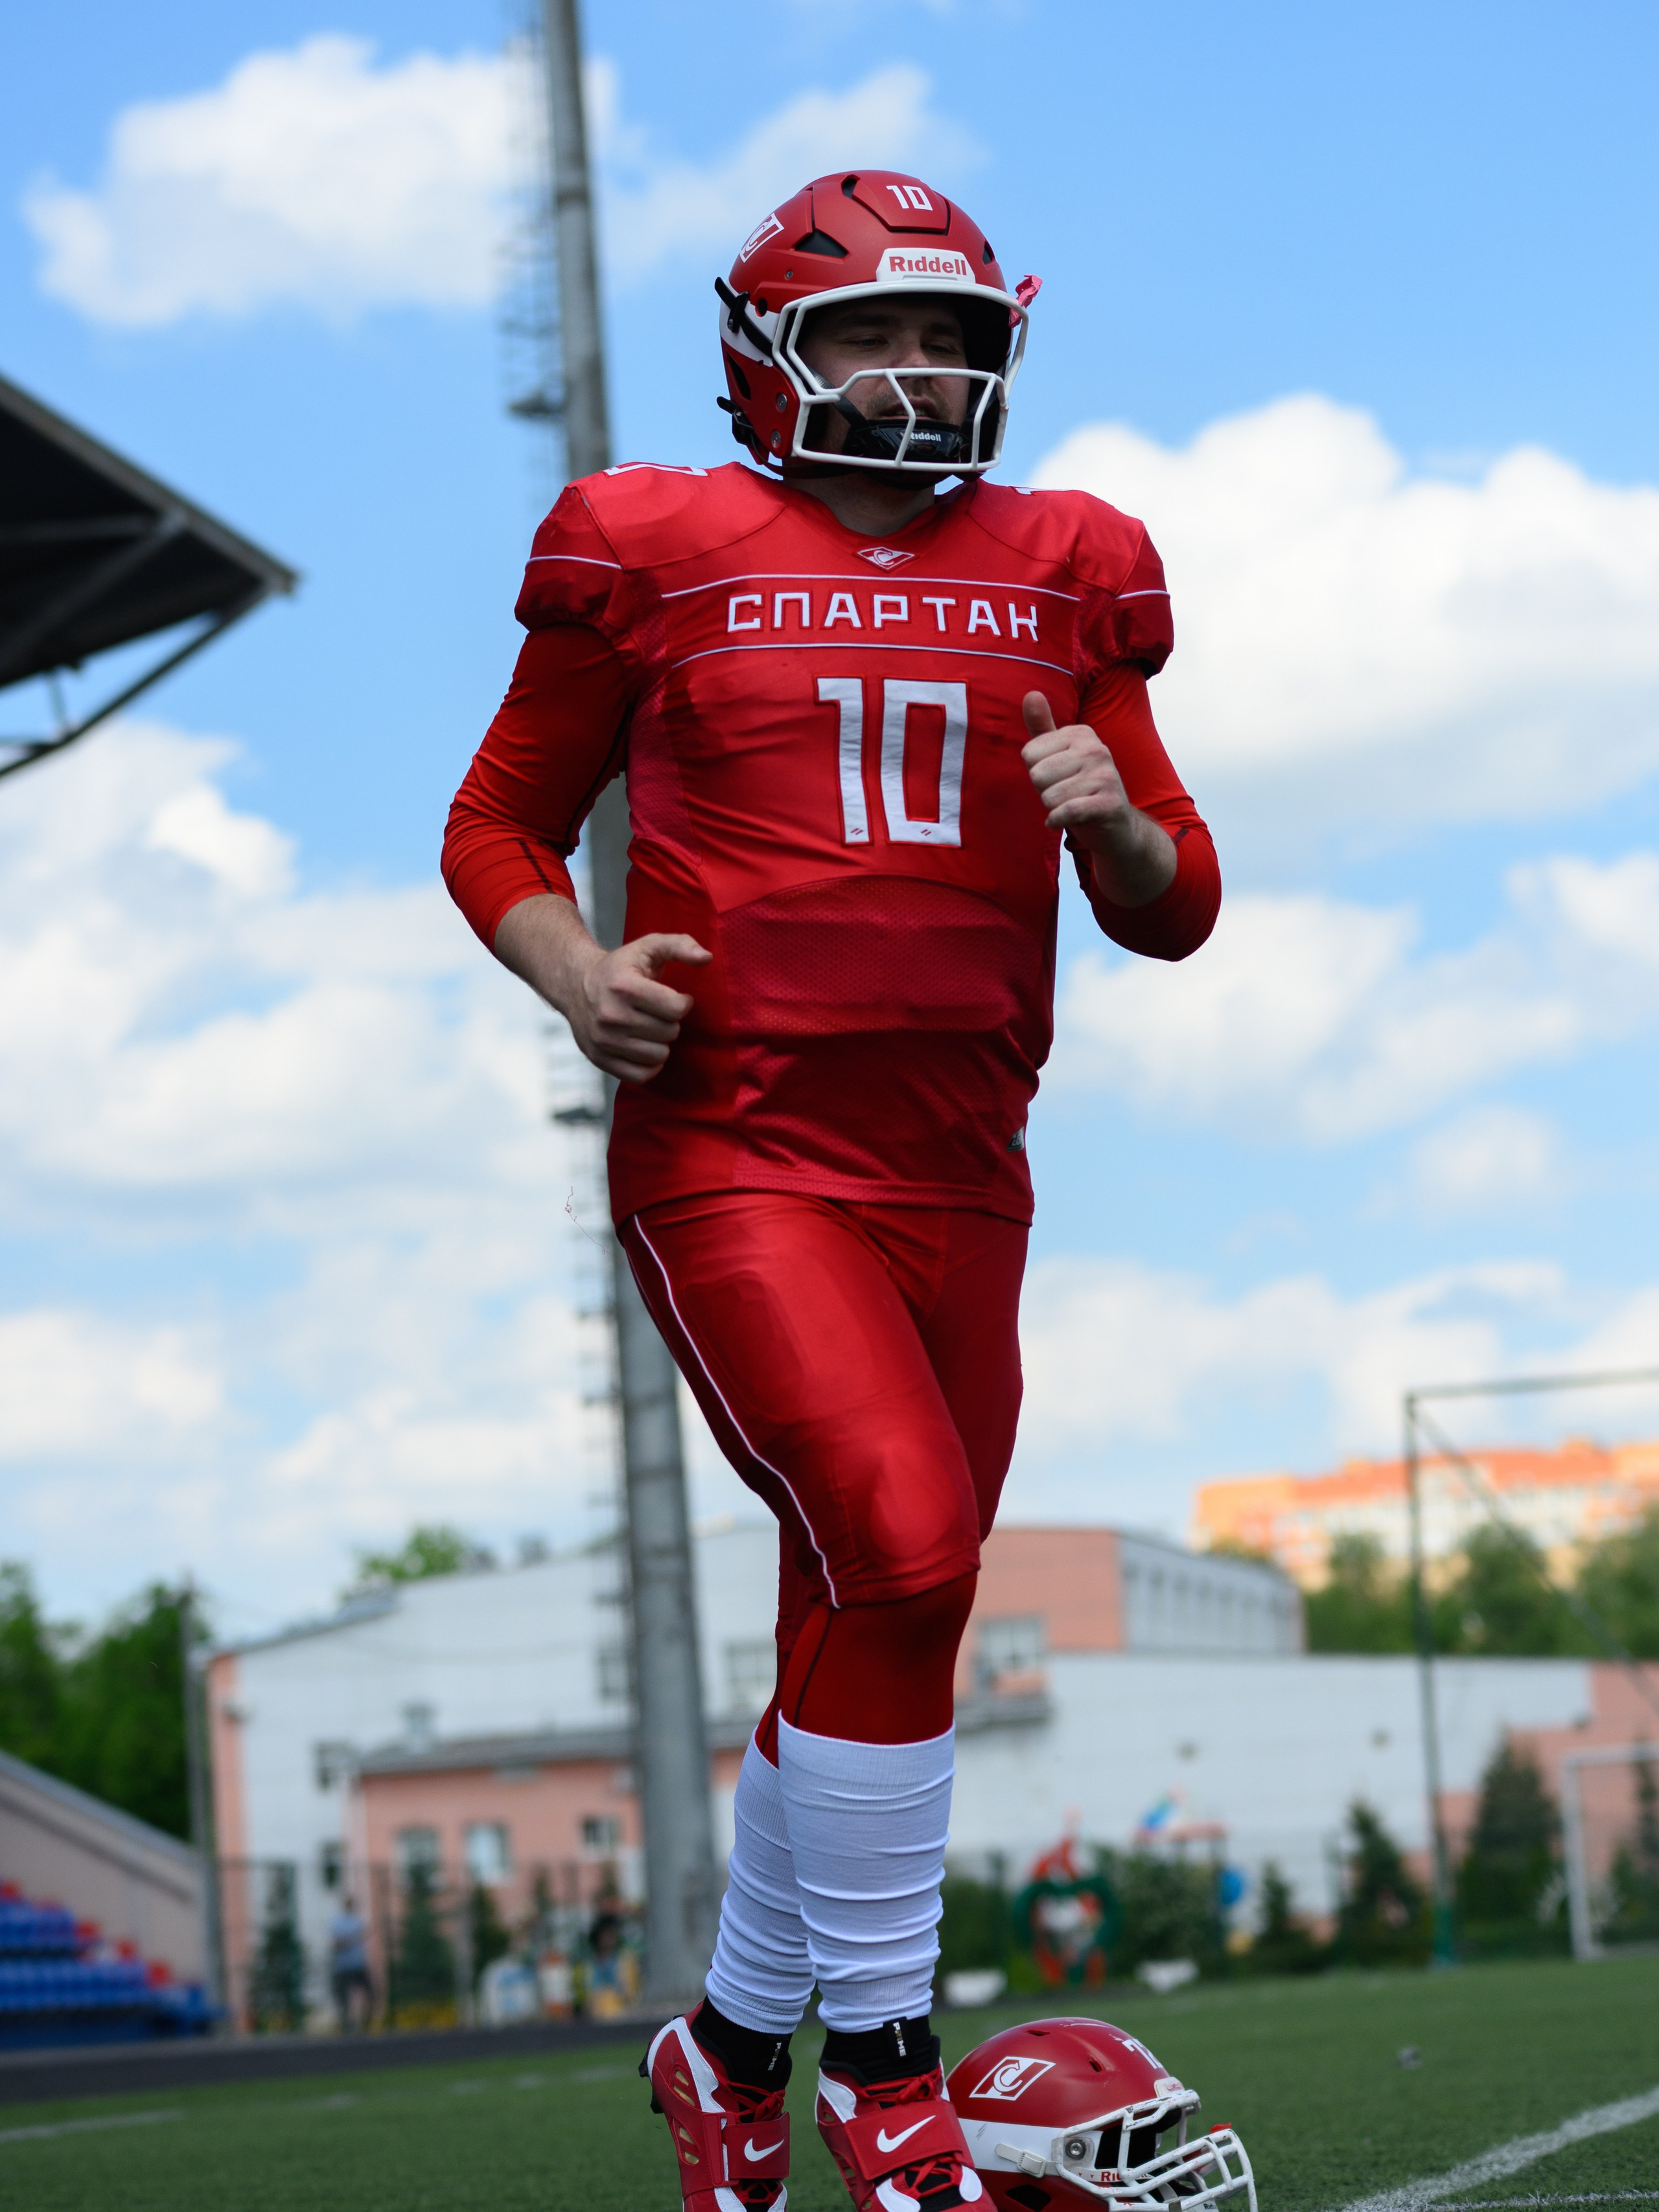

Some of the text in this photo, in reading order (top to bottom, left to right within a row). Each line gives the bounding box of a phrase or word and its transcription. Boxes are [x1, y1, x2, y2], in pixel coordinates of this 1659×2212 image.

[886, 185, 933, 211] 10
[889, 256, 967, 275] Riddell
[727, 592, 1039, 642] СПАРТАК
[817, 678, 969, 846] 10
